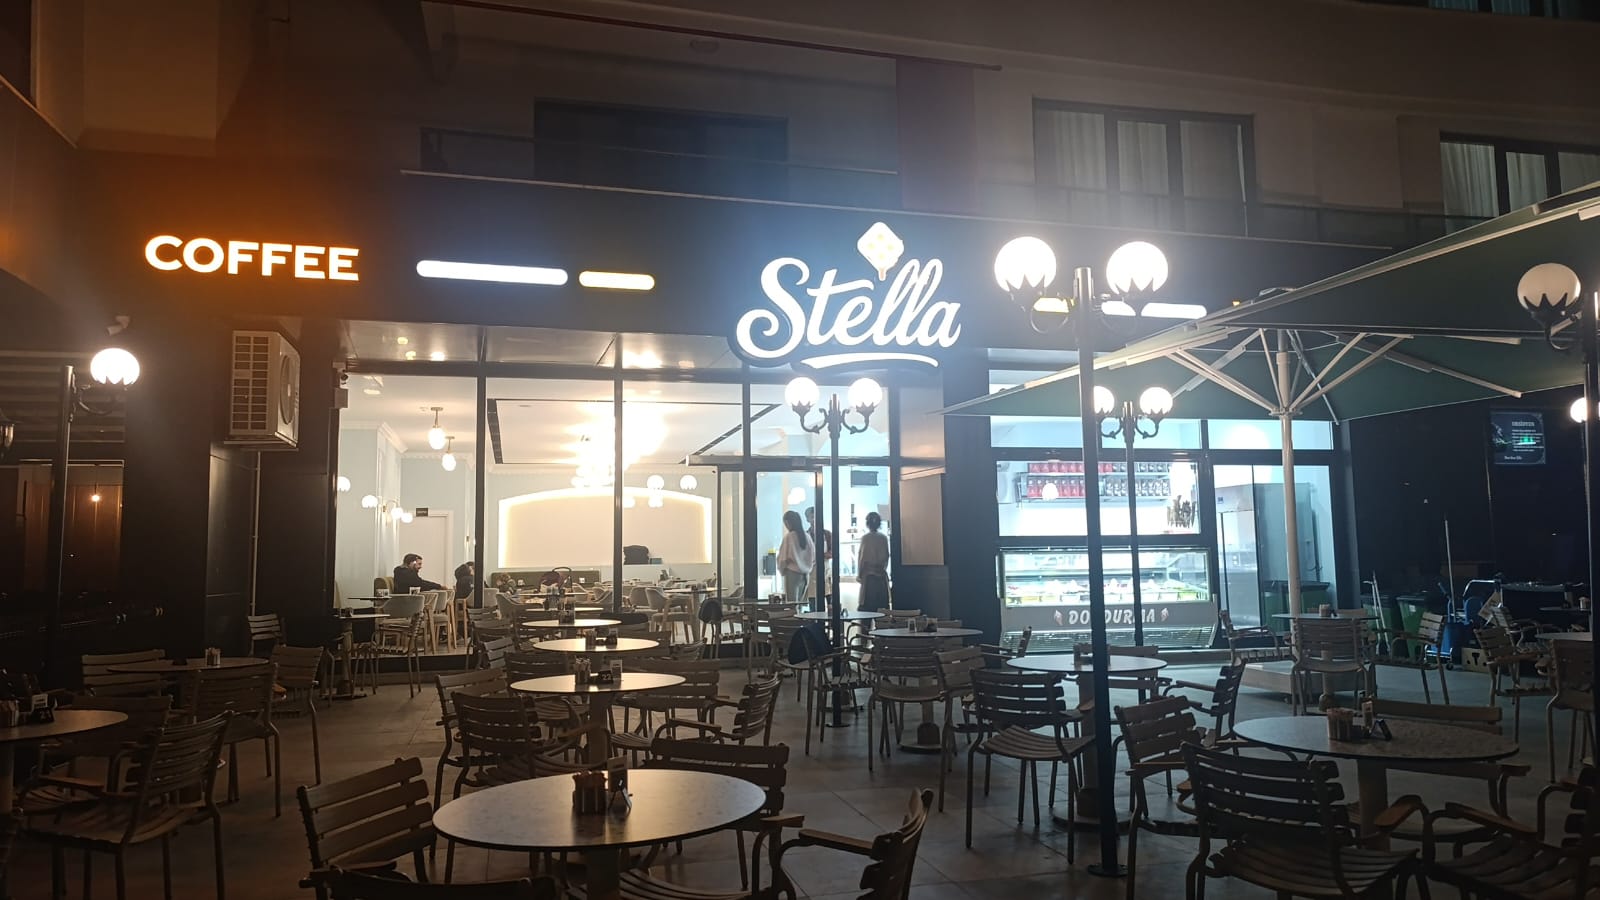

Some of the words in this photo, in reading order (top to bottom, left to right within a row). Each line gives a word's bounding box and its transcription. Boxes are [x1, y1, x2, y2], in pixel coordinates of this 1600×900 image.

[144, 235, 360, 282] COFFEE
[736, 256, 961, 359] Stella
[1068, 608, 1156, 625] DODURA
